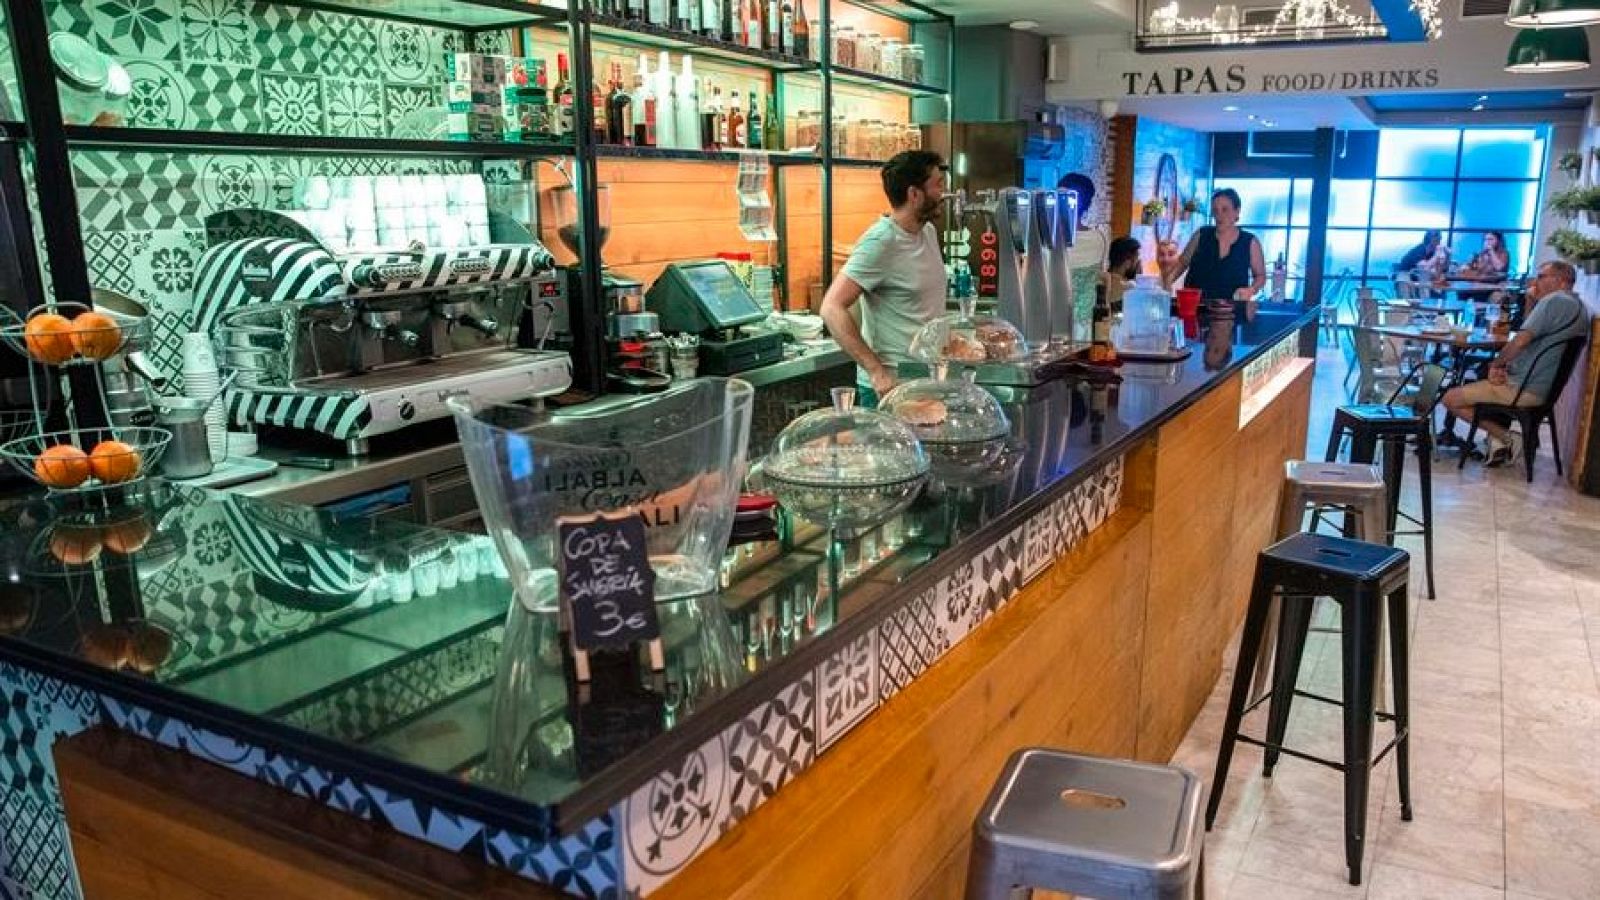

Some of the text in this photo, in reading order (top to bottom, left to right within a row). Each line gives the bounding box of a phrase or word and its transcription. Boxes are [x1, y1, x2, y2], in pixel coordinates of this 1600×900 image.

[1122, 65, 1440, 95] TAPAS FOOD/DRINKS
[980, 231, 997, 290] 1890
[589, 554, 621, 575] DE
